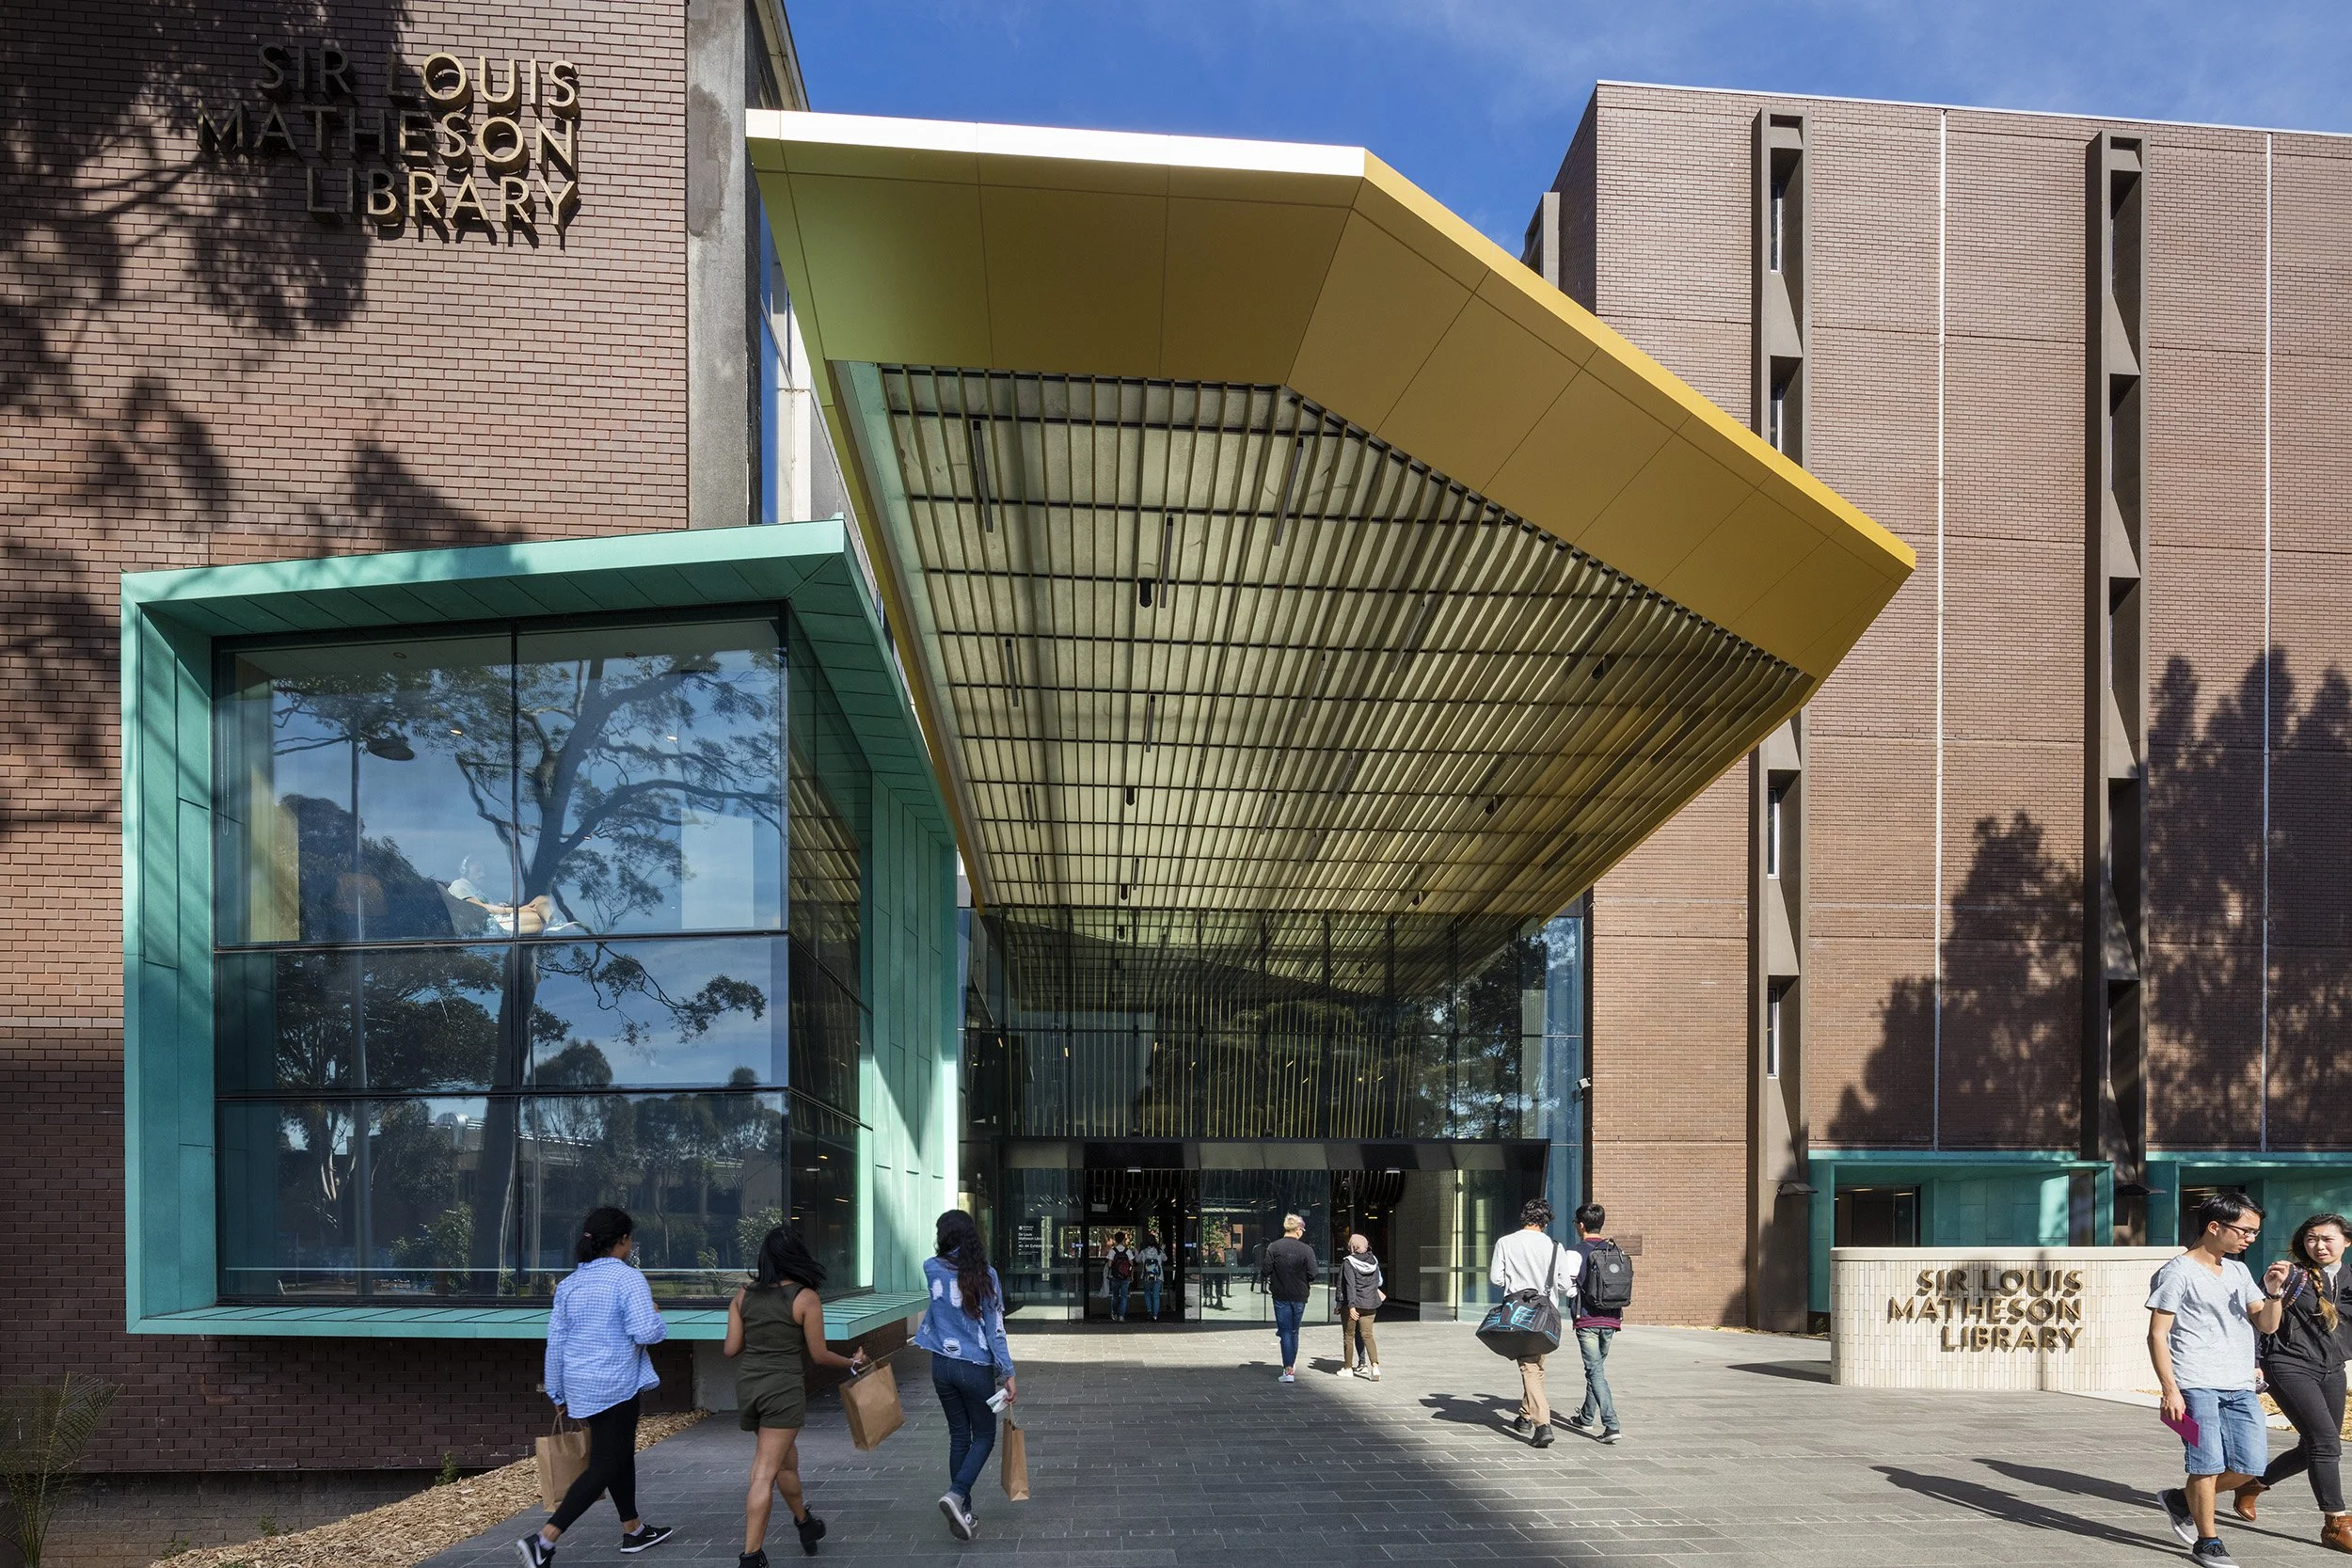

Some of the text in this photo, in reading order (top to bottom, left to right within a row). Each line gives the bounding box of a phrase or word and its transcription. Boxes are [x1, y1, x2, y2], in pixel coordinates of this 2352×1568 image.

[255, 41, 580, 109] SIR LOUIS
[196, 98, 579, 170] MATHESON
[306, 166, 576, 227] LIBRARY
[1916, 1270, 2084, 1294] SIR LOUIS
[1889, 1296, 2082, 1323] MATHESON
[1942, 1324, 2083, 1350] LIBRARY
